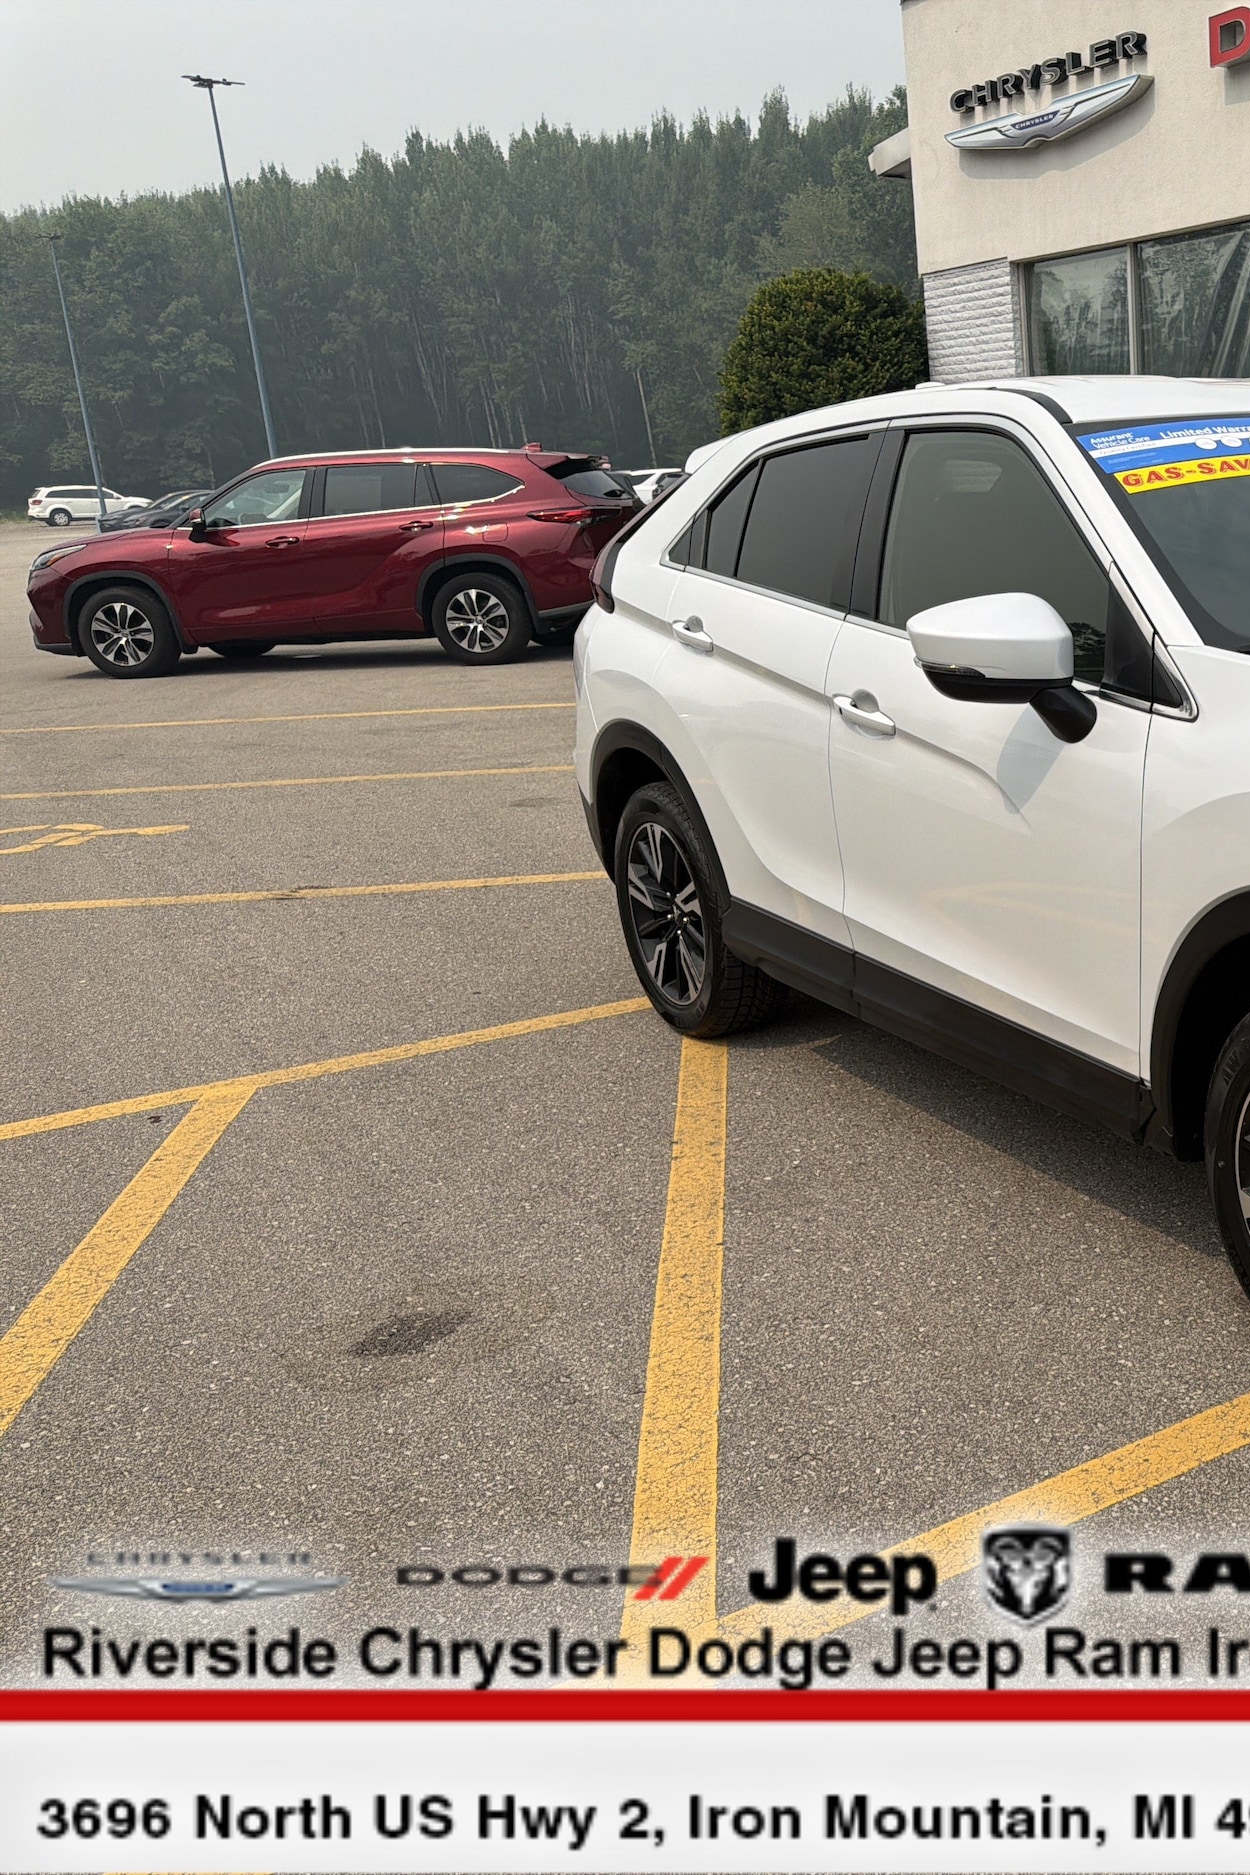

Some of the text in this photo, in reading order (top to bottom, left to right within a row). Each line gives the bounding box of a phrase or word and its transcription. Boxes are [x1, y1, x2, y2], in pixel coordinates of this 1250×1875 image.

[949, 31, 1146, 114] CHRYSLER
[1014, 113, 1055, 130] CHRYSLER
[1090, 431, 1134, 444] Assurant
[1159, 427, 1212, 440] Limited
[1092, 435, 1151, 450] Vehicle Care
